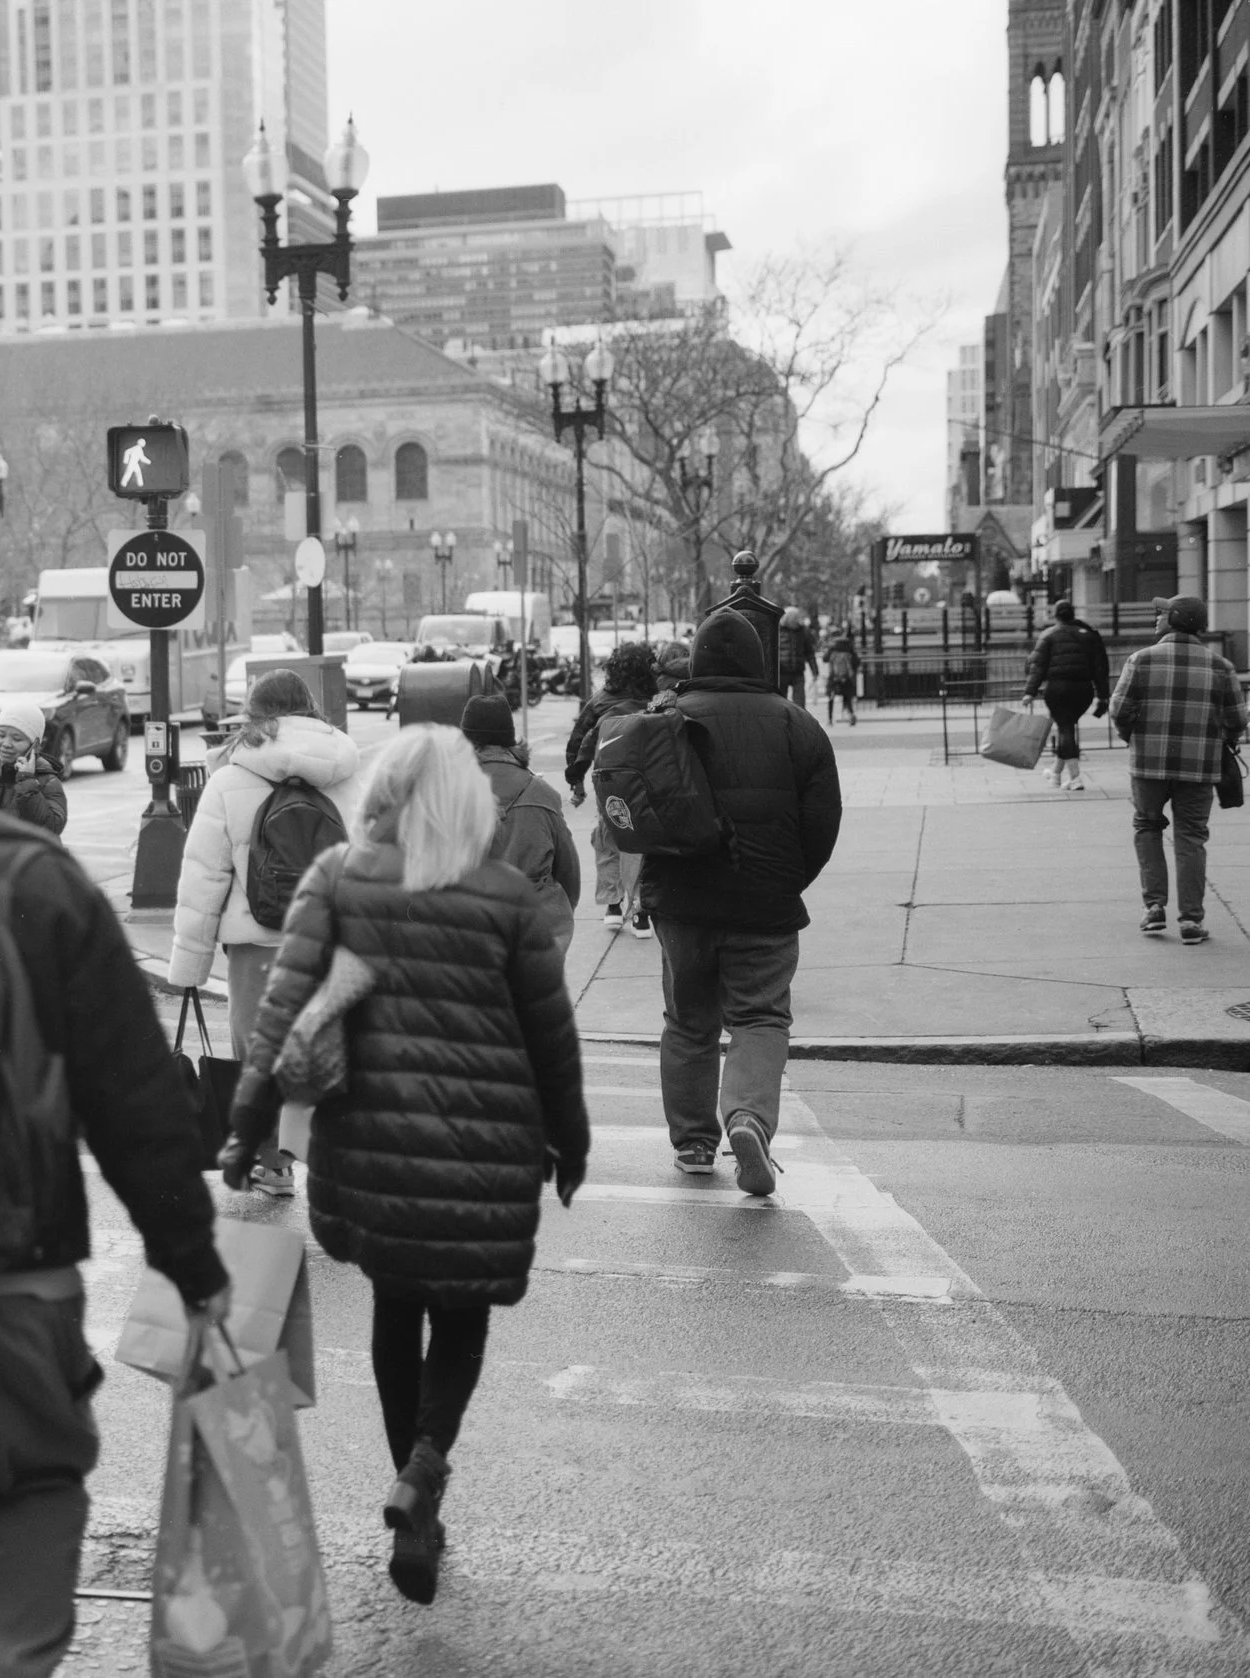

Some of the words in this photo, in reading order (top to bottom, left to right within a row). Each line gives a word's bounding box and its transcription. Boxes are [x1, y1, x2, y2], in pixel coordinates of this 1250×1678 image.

[886, 536, 963, 561] Yamato
[126, 552, 147, 567] DO
[157, 552, 187, 567] NOT
[131, 593, 182, 608] ENTER
